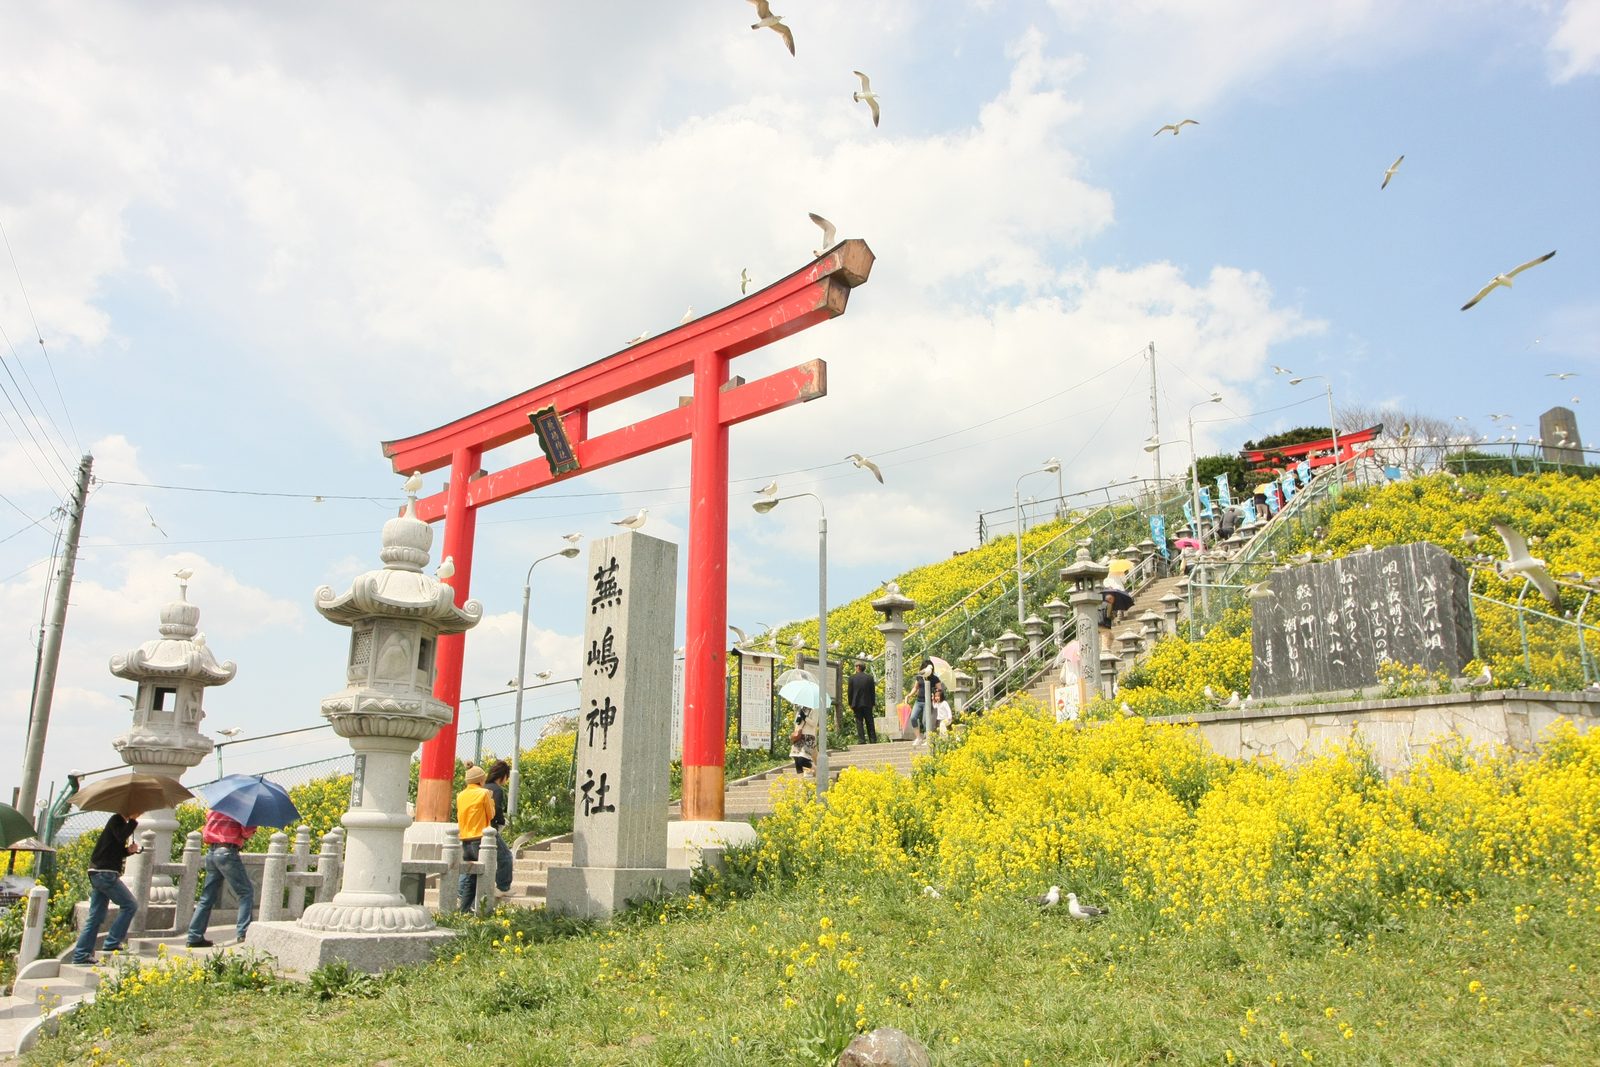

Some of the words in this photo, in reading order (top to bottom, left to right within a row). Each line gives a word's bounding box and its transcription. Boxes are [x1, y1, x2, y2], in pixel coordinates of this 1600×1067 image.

[1382, 560, 1405, 637] 唄に夜明けた
[1418, 575, 1444, 650] 八戸小唄
[580, 556, 623, 817] 蕪嶋神社
